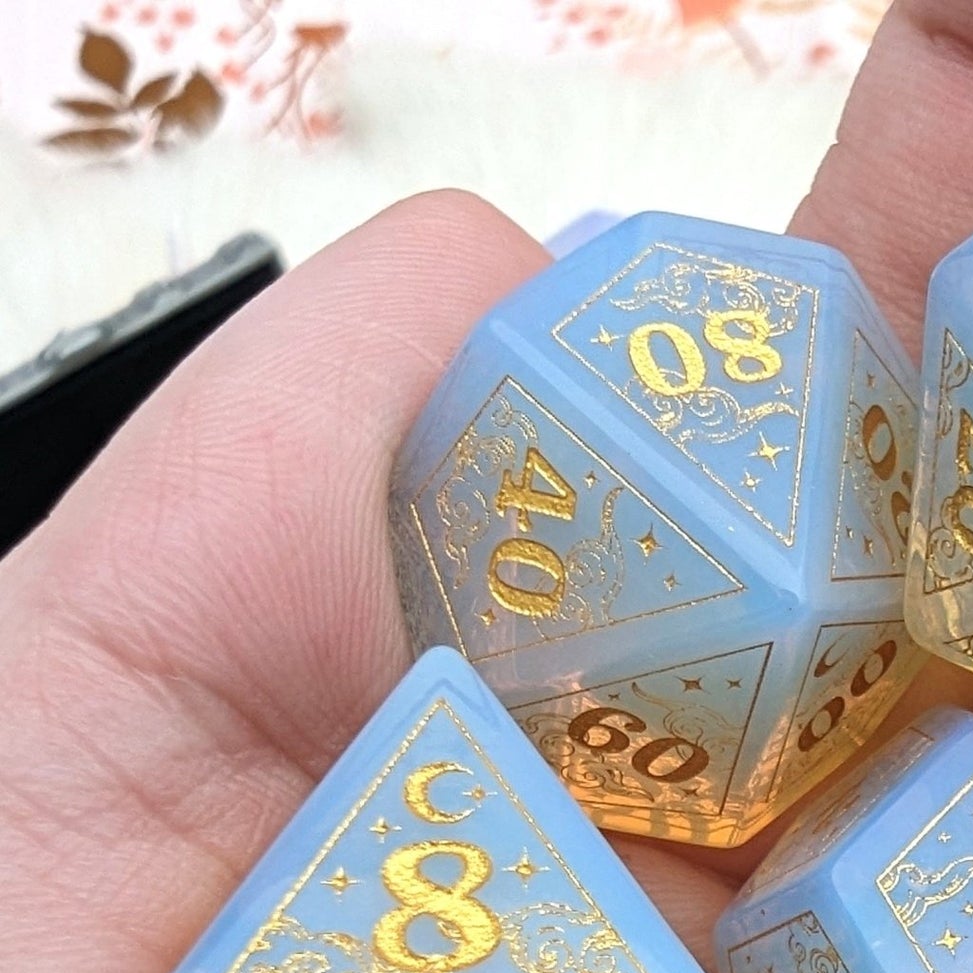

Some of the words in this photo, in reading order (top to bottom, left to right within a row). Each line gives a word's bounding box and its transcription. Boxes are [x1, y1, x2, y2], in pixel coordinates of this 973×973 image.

[488, 446, 577, 617] 40
[567, 706, 710, 784] 60
[798, 639, 897, 752] 00
[373, 841, 502, 972] 8
